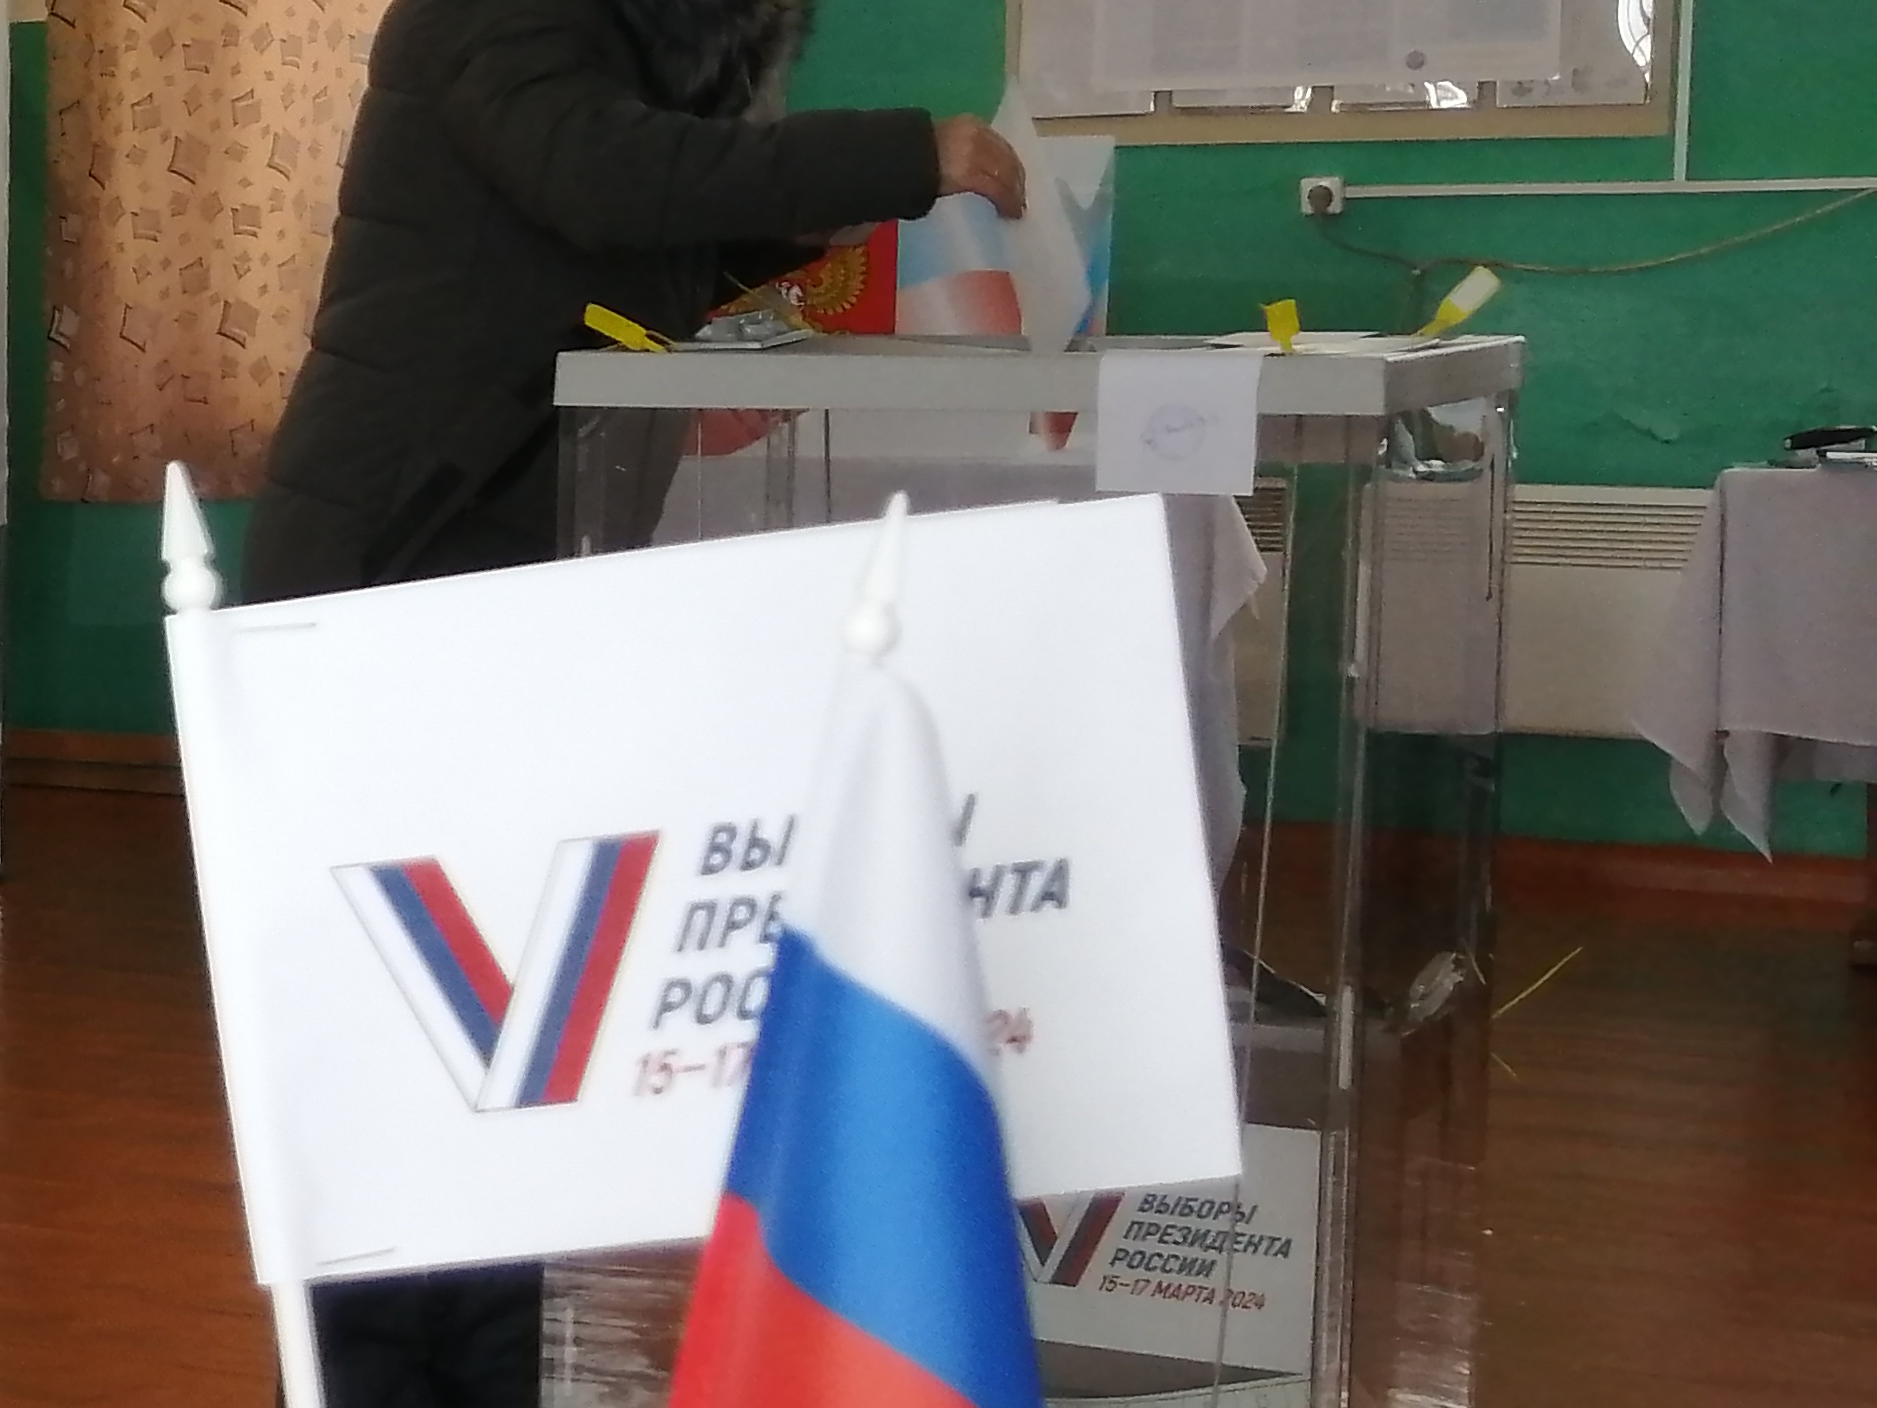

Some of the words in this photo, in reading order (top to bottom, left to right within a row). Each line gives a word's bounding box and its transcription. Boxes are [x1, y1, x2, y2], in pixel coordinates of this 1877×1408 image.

[1137, 1192, 1259, 1225] ВЫБОРЫ
[1122, 1220, 1294, 1260] ПРЕЗИДЕНТА
[1108, 1248, 1218, 1279] РОССИИ
[1150, 1281, 1215, 1306] МАРТА
[1217, 1288, 1267, 1311] 2024
